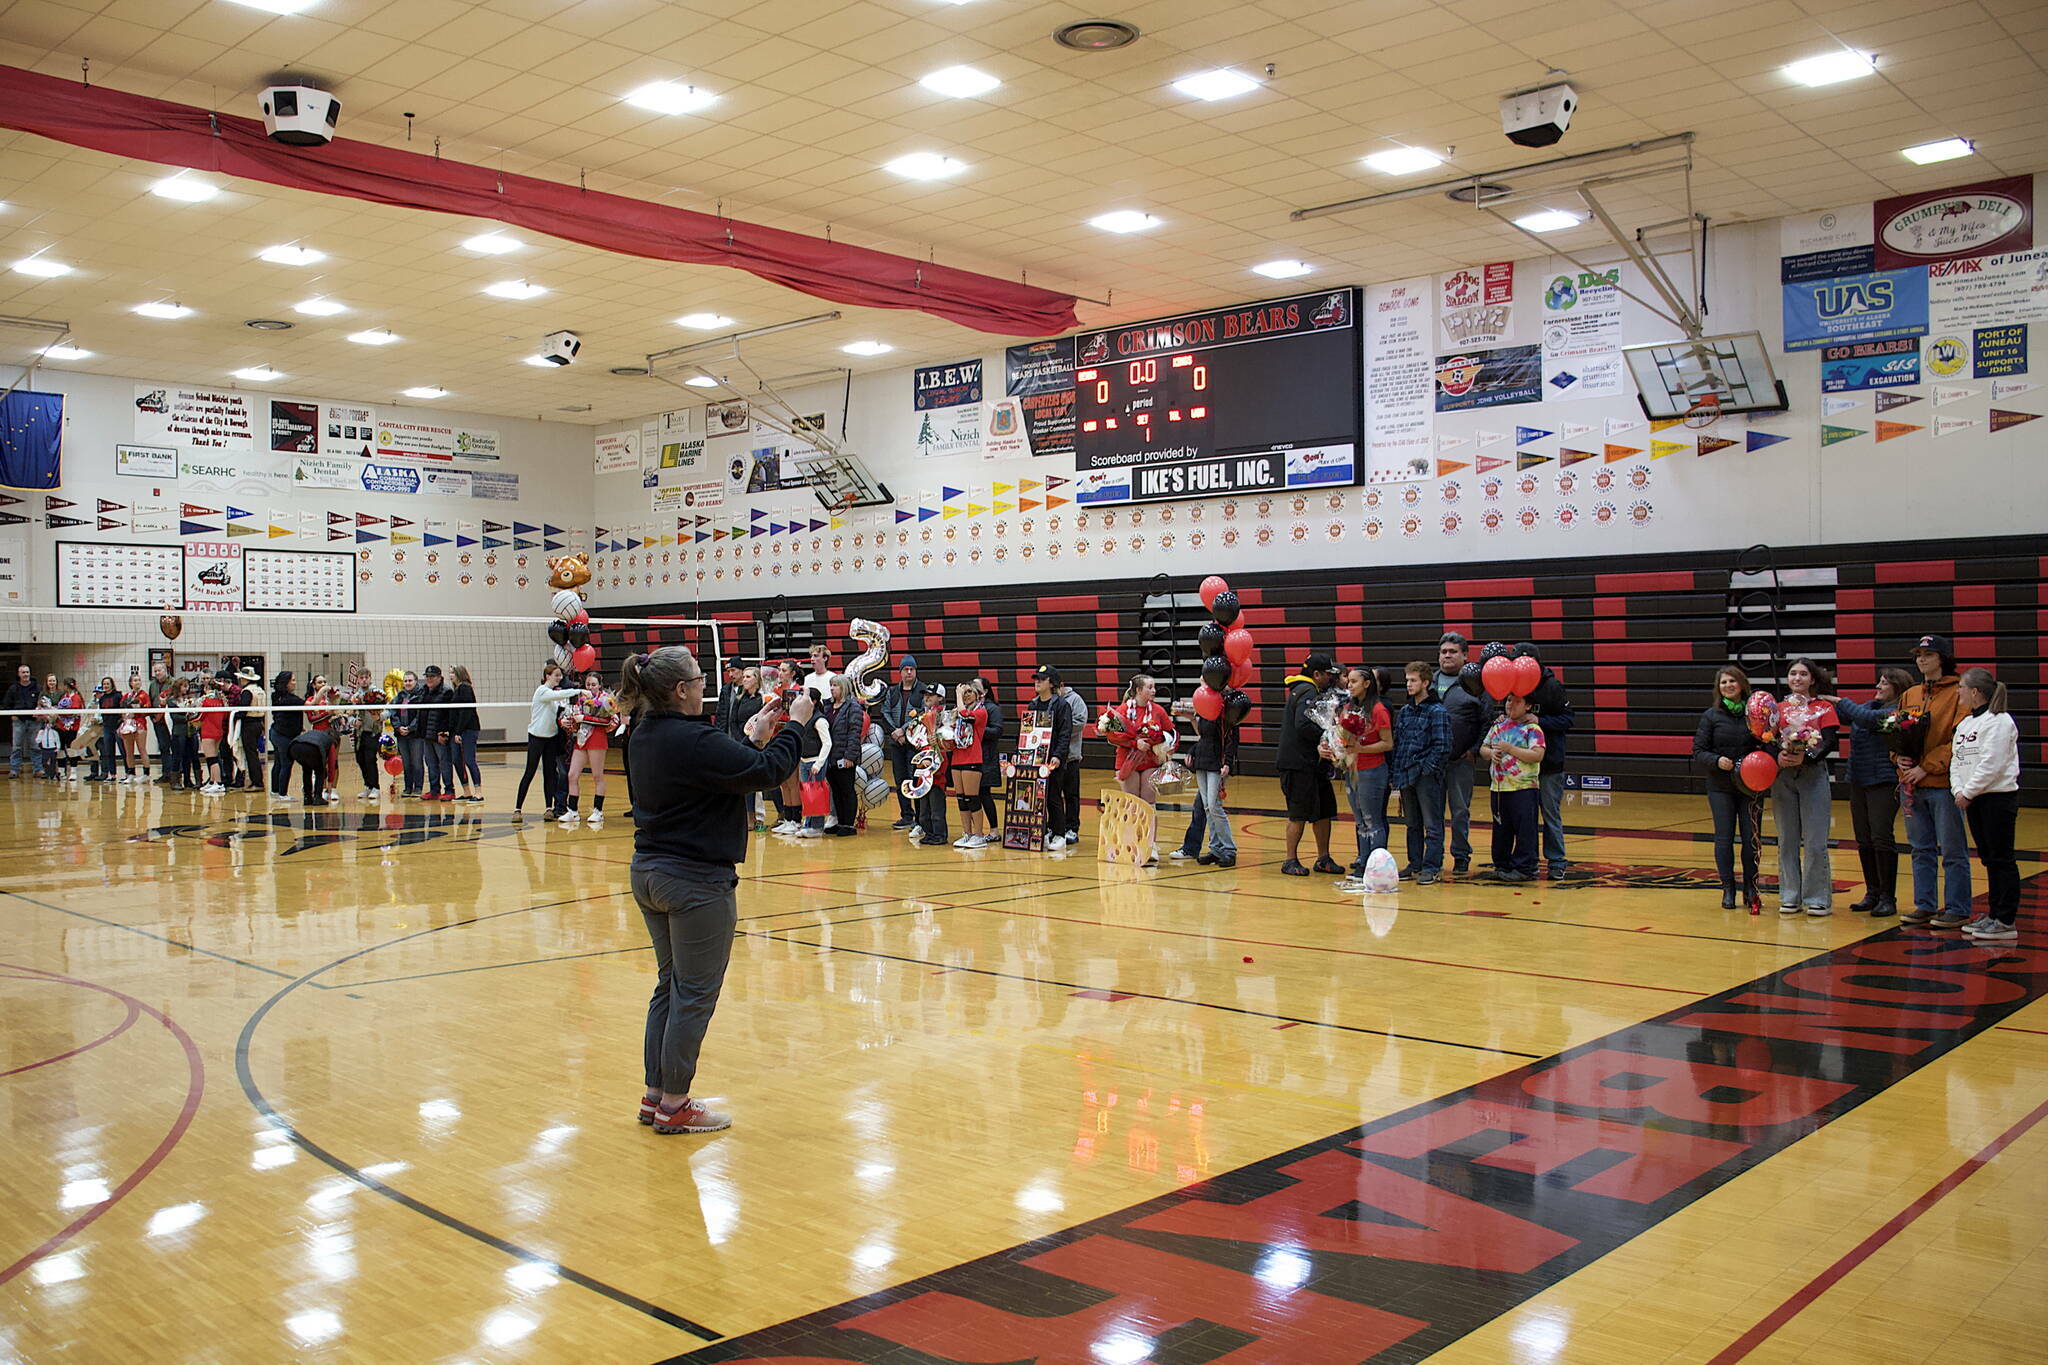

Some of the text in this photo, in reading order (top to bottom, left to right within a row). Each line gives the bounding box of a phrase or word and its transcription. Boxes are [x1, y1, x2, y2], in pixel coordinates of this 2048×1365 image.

[1978, 200, 2012, 216] DELI
[1929, 255, 2003, 278] RE/MAX of
[1445, 274, 1480, 291] RED DOG
[1446, 289, 1479, 307] SALOON
[1815, 281, 1893, 319] UAS
[1543, 316, 1582, 325] Cornerstone
[1584, 312, 1603, 320] Home
[1117, 304, 1300, 356] CRIMSON BEARS
[1827, 320, 1883, 333] SOUTHEAST
[1978, 328, 2023, 340] PORT OF
[1978, 337, 2022, 348] JUNEAU
[1827, 340, 1913, 359] GO BEARS!
[1982, 349, 2005, 358] UNIT
[1042, 358, 1064, 367] SUPPORTS
[1976, 357, 2024, 368] SUPPORTS
[1012, 362, 1074, 380] BEARS BASKETBALL
[1988, 366, 2012, 374] JDHS
[918, 364, 978, 390] I.B.E.W.
[1194, 366, 1206, 390] 0
[1869, 374, 1915, 386] EXCAVATION
[1582, 380, 1616, 389] insurance
[196, 392, 210, 402] School
[212, 394, 229, 404] District
[1097, 380, 1108, 404] 0
[1494, 388, 1536, 400] VOLLEYBALL
[1023, 394, 1060, 410] CARPENTERS
[1132, 396, 1154, 410] period
[204, 406, 224, 415] partially
[225, 407, 240, 416] funded
[242, 408, 248, 418] by
[1035, 408, 1052, 419] LOCAL
[214, 417, 223, 426] City
[230, 418, 248, 428] Borough
[272, 422, 312, 432] SPORTSMANSHIP
[378, 422, 402, 430] CAPITAL
[192, 426, 210, 436] through
[951, 428, 980, 442] Nizich
[1146, 427, 1150, 442] 1
[192, 437, 210, 446] Thank
[472, 443, 496, 451] Oncology
[680, 440, 704, 450] ALASKA
[932, 440, 980, 451] FAMILY DENTAL
[679, 448, 702, 458] MARINE
[1090, 445, 1198, 466] Scoreboard provided by
[300, 460, 352, 470] Nizich Family
[678, 458, 695, 466] LINES
[192, 464, 236, 478] SEARHC
[242, 470, 268, 478] healthy
[314, 468, 339, 476] Dental
[363, 464, 416, 478] ALASKA
[1141, 459, 1275, 494] IKE'S FUEL, INC.
[190, 584, 204, 593] Fast
[226, 586, 240, 594] Club
[1008, 815, 1043, 824] SENIOR
[720, 1049, 1858, 1365] BEAR
